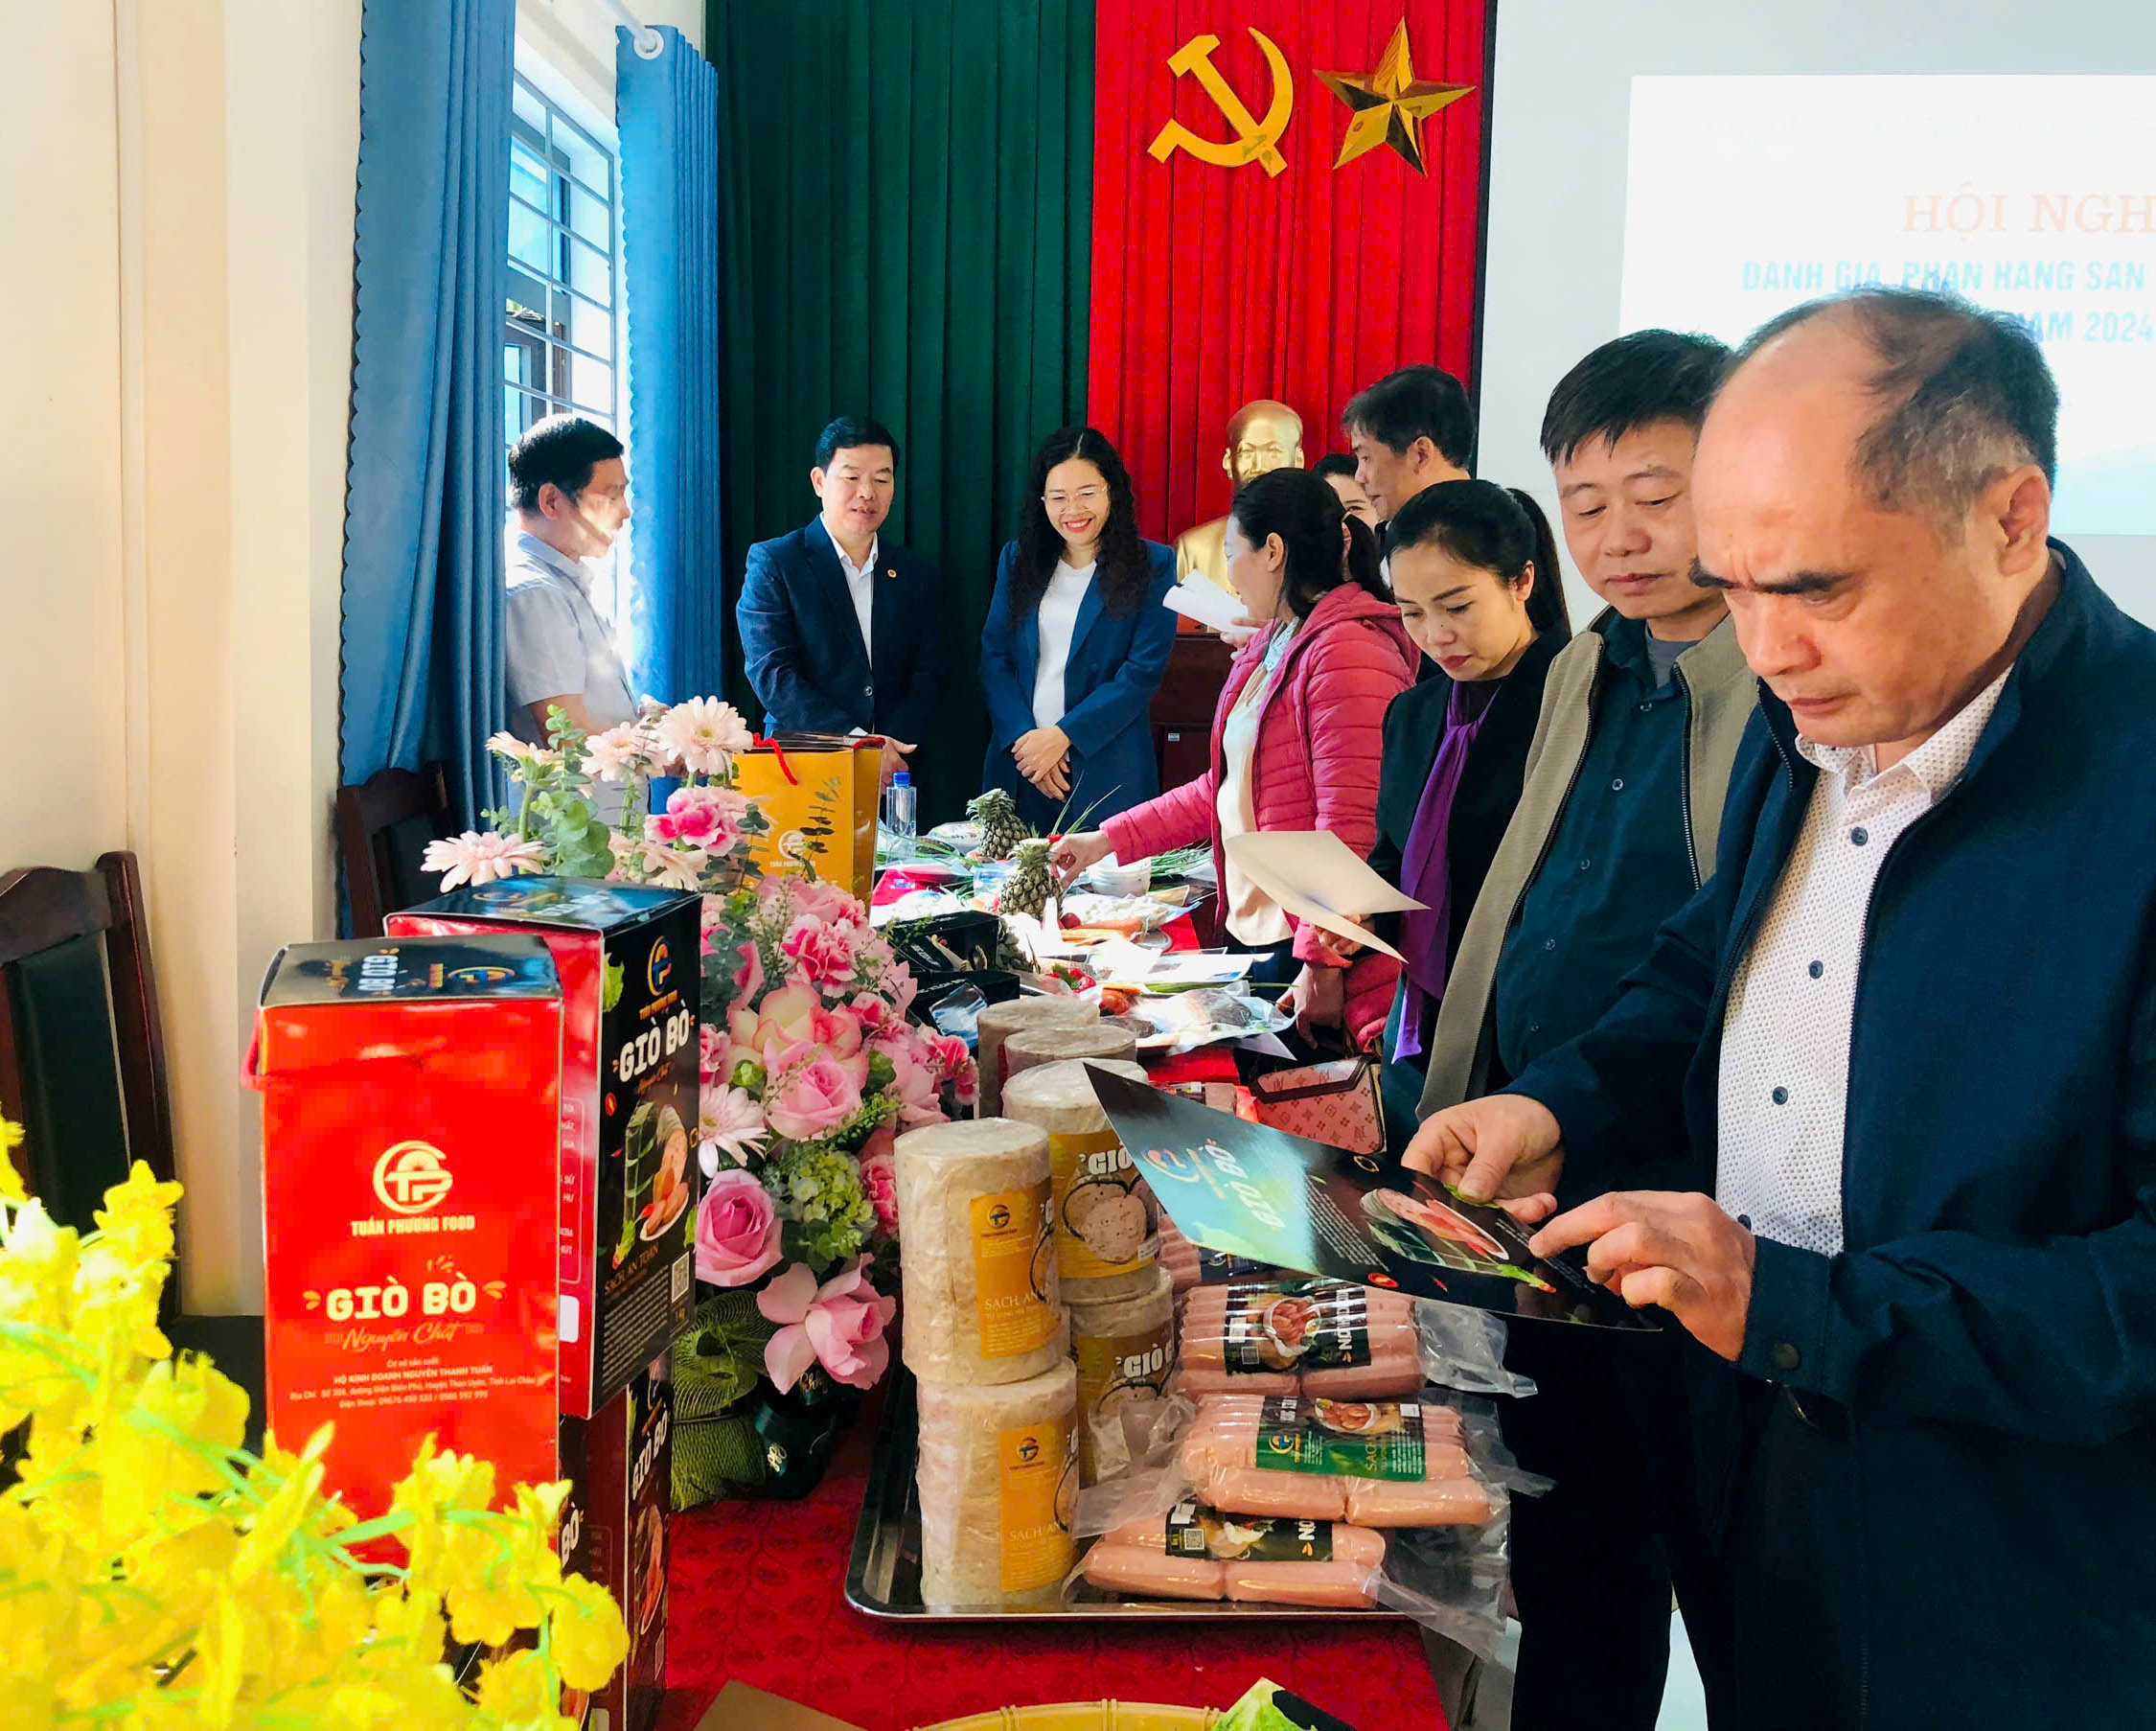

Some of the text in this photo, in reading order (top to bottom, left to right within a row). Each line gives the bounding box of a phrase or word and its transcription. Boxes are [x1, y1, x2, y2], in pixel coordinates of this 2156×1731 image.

[2084, 311, 2155, 342] 2024
[619, 1017, 662, 1084] GIÒ
[665, 998, 690, 1055] BÒ
[442, 1214, 475, 1232] FOOD
[327, 1271, 477, 1321] GIÒ BÒ
[1124, 1343, 1163, 1378] GIÒ
